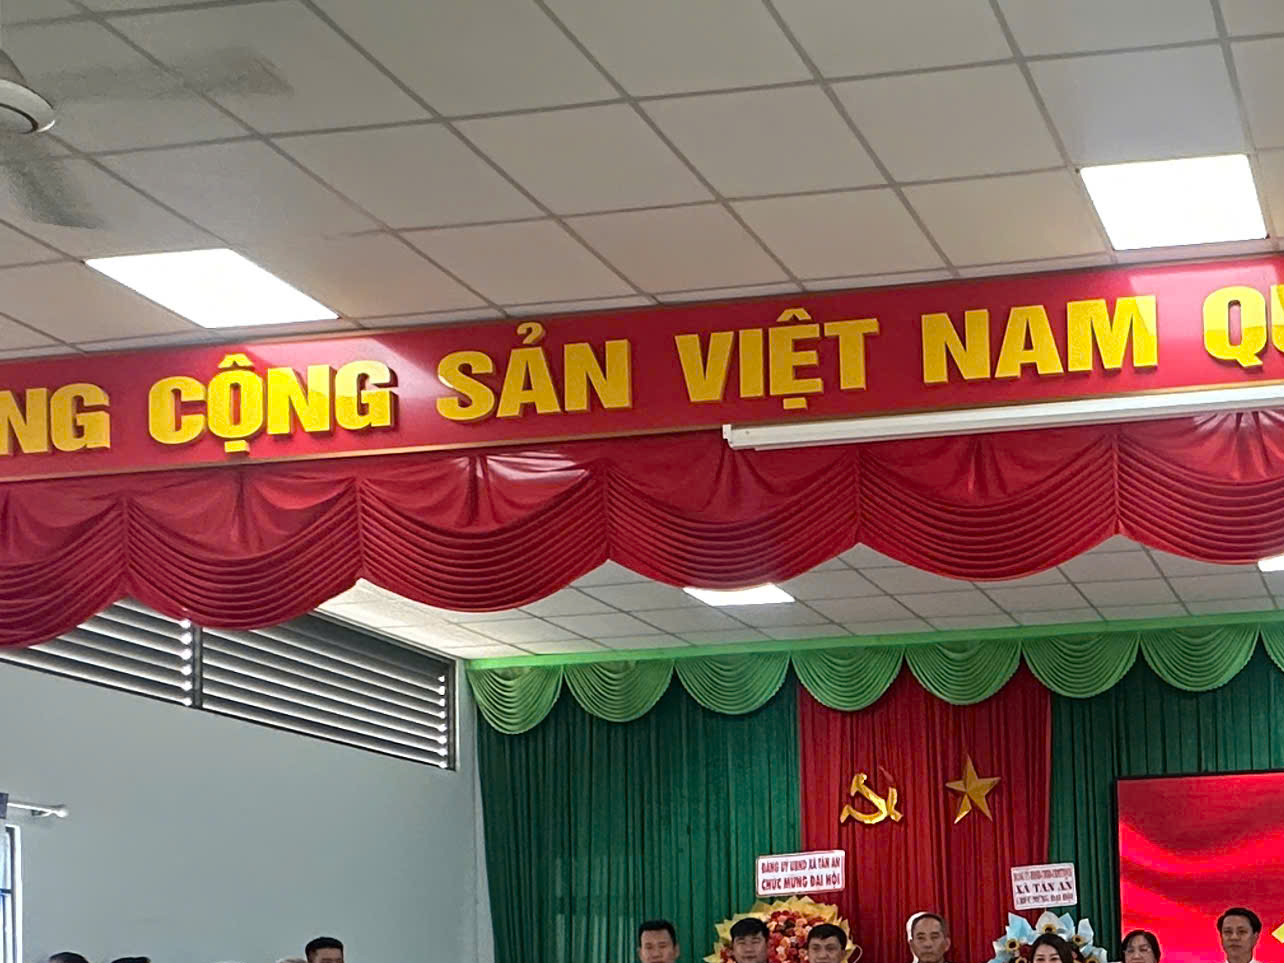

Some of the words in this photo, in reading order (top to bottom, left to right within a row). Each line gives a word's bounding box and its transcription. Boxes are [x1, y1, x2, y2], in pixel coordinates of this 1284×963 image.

[149, 354, 396, 453] CỘNG
[437, 321, 633, 421] SẢN
[676, 307, 880, 409] VIỆT
[921, 295, 1159, 384] NAM
